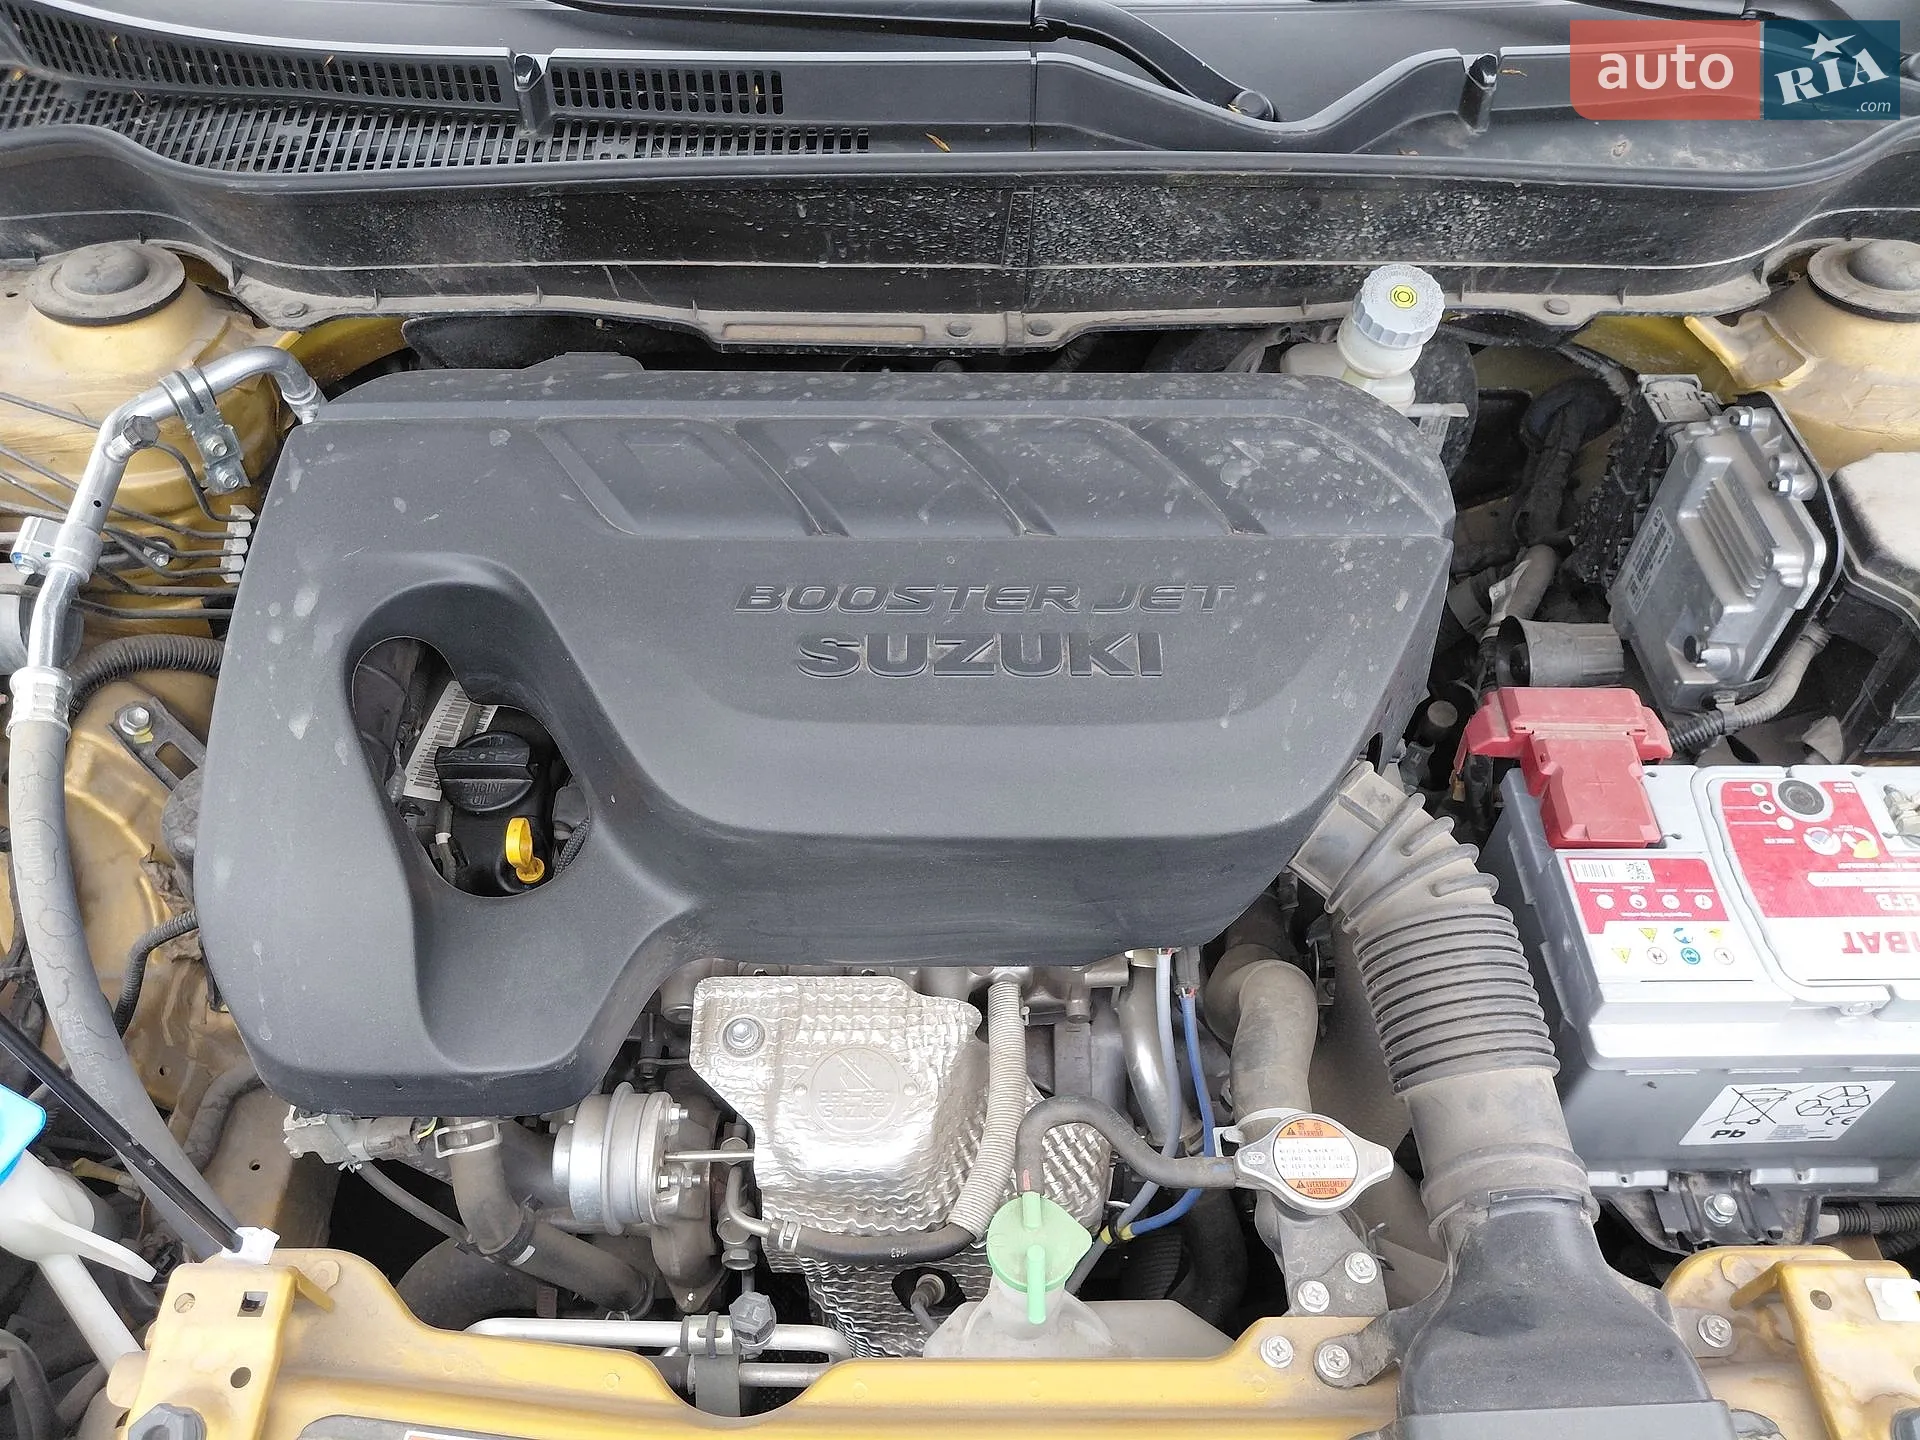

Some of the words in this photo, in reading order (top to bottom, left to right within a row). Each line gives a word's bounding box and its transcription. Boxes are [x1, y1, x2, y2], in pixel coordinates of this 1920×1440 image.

[735, 583, 1080, 614] BOOSTER
[797, 631, 1164, 678] SUZUKI
[463, 782, 505, 793] ENGINE
[472, 795, 490, 806] OIL
[1710, 1129, 1746, 1139] Pb
